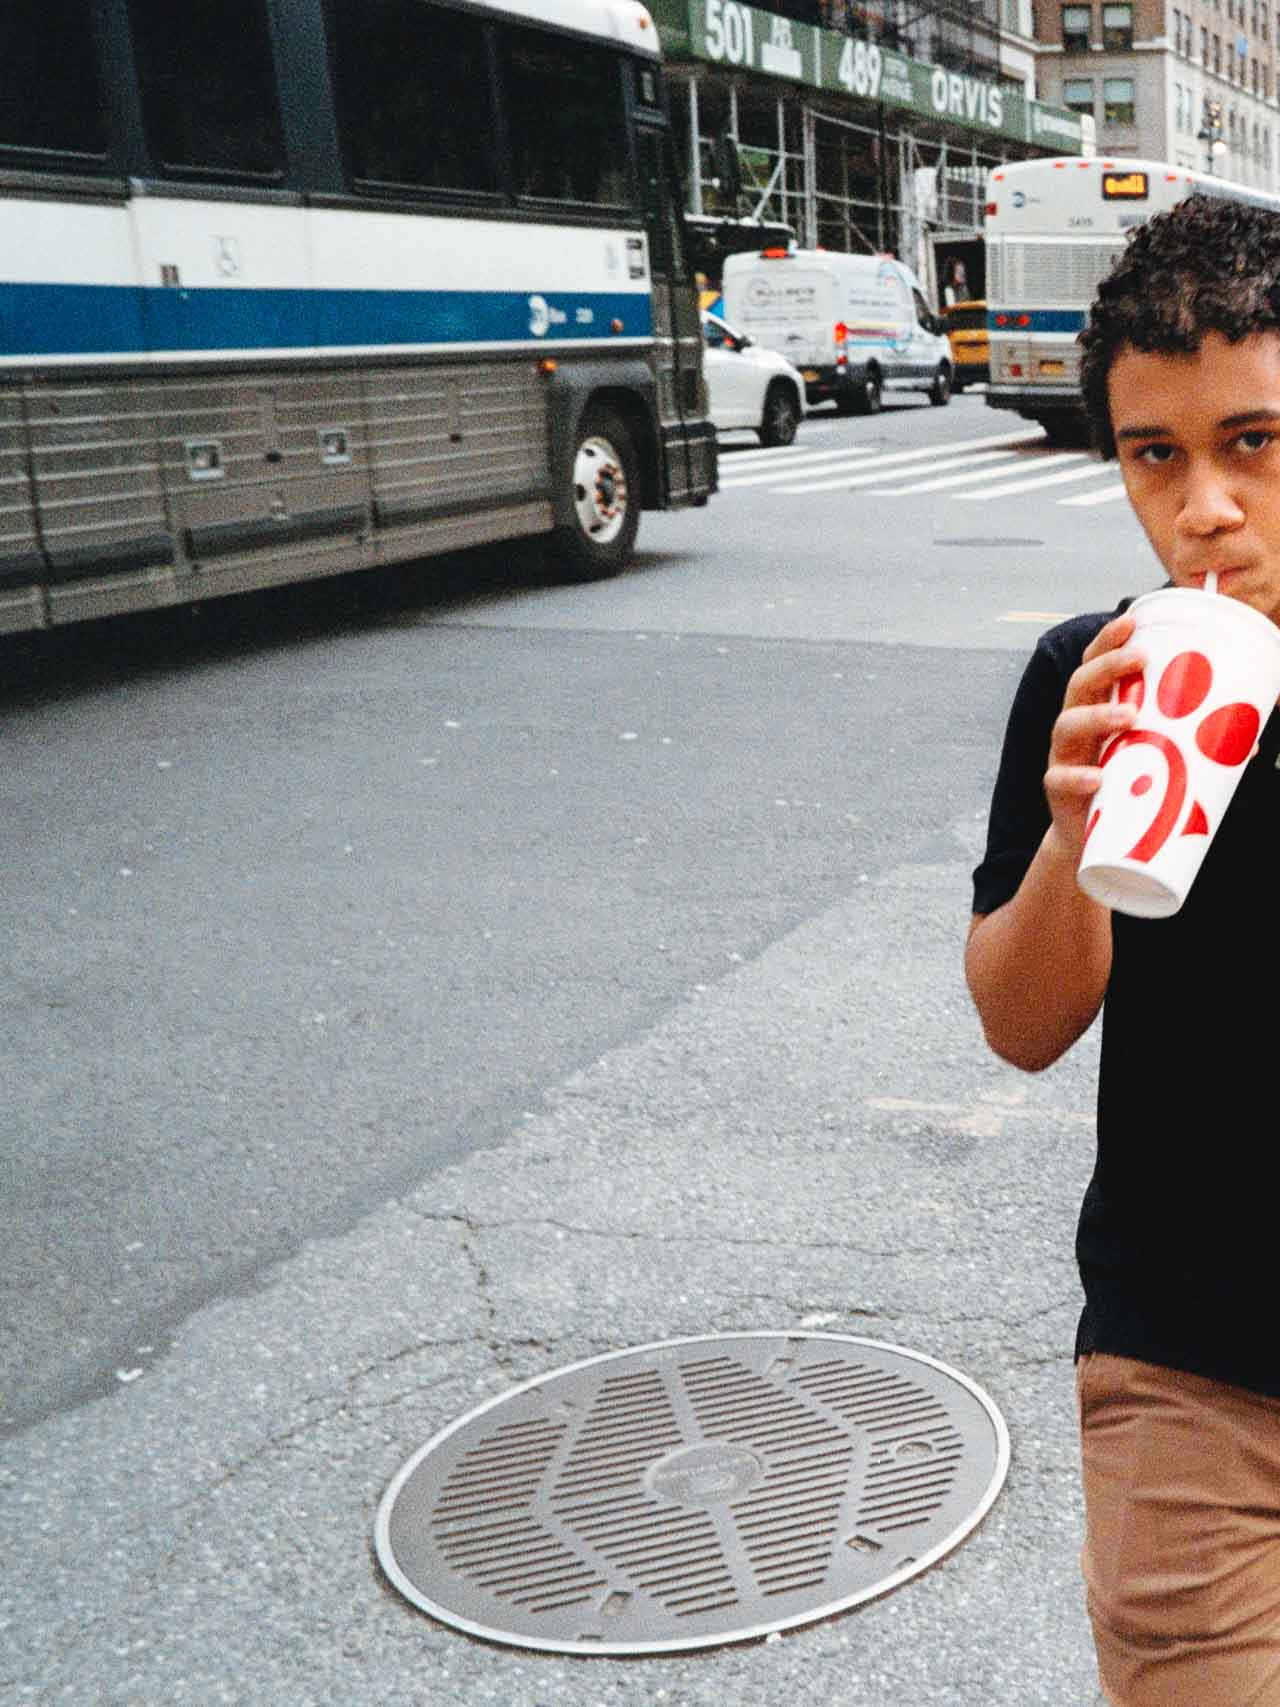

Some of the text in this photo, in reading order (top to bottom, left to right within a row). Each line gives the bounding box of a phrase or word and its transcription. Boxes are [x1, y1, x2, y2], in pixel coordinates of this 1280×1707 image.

[704, 0, 753, 68] 501
[838, 37, 881, 97] 489
[931, 70, 1004, 127] ORVIS
